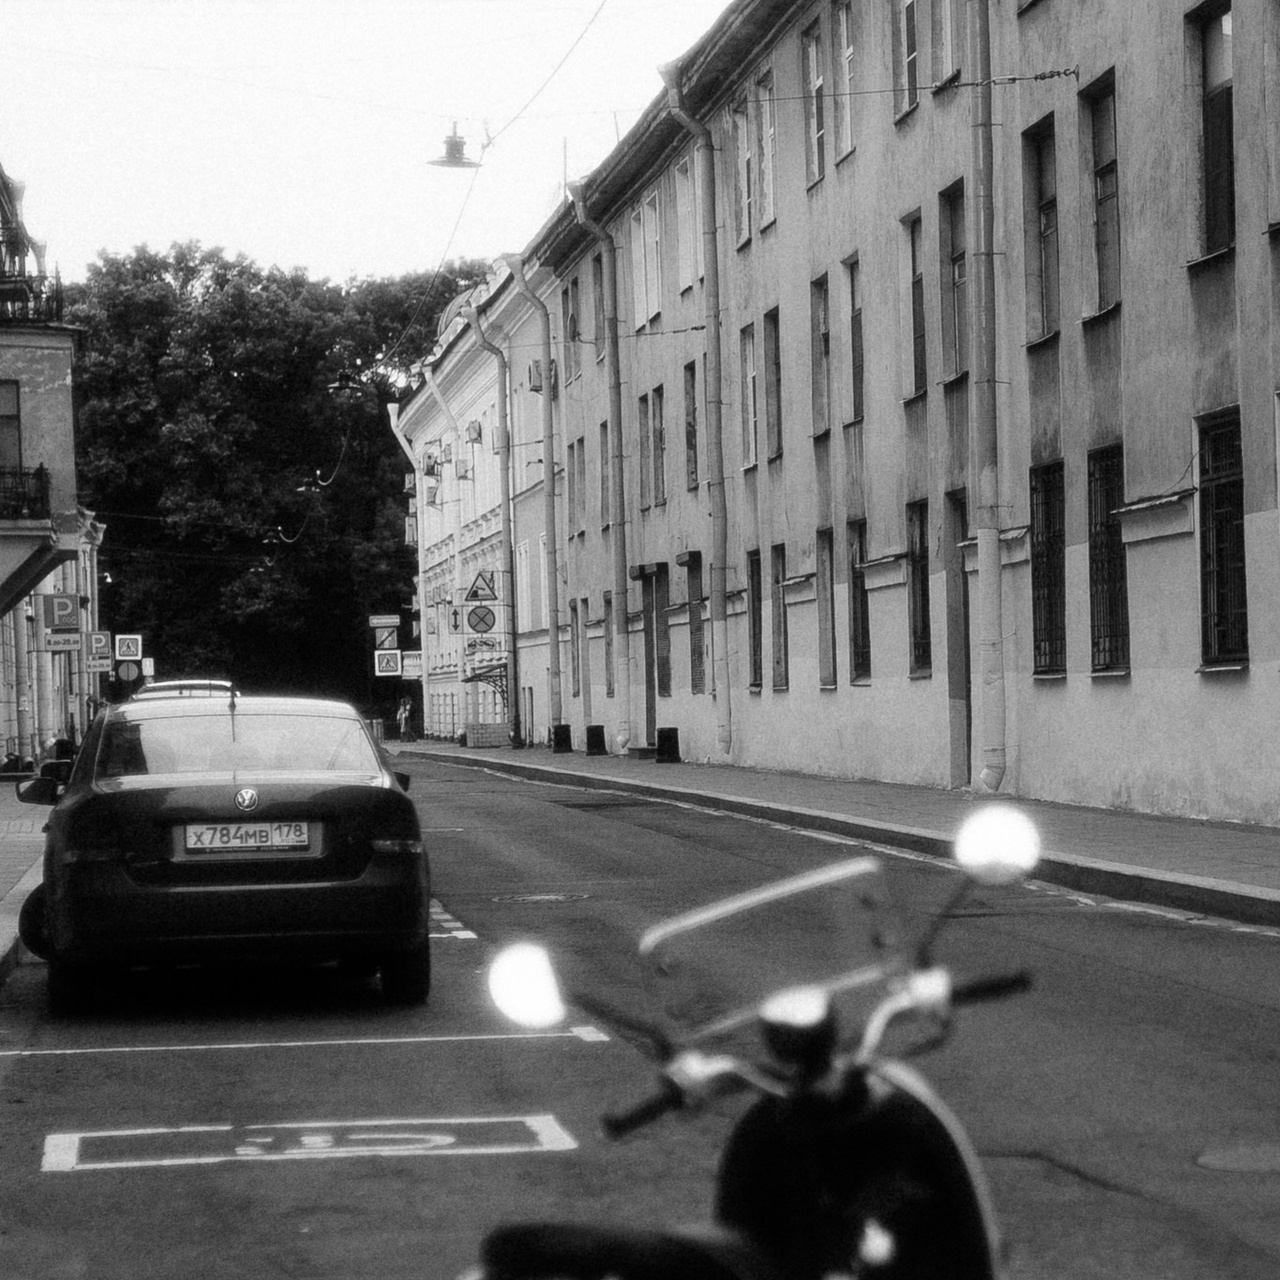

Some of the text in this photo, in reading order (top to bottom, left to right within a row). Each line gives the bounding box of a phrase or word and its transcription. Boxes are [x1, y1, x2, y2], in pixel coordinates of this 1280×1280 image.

[53, 598, 72, 625] P
[92, 635, 106, 654] P
[274, 824, 303, 838] 178
